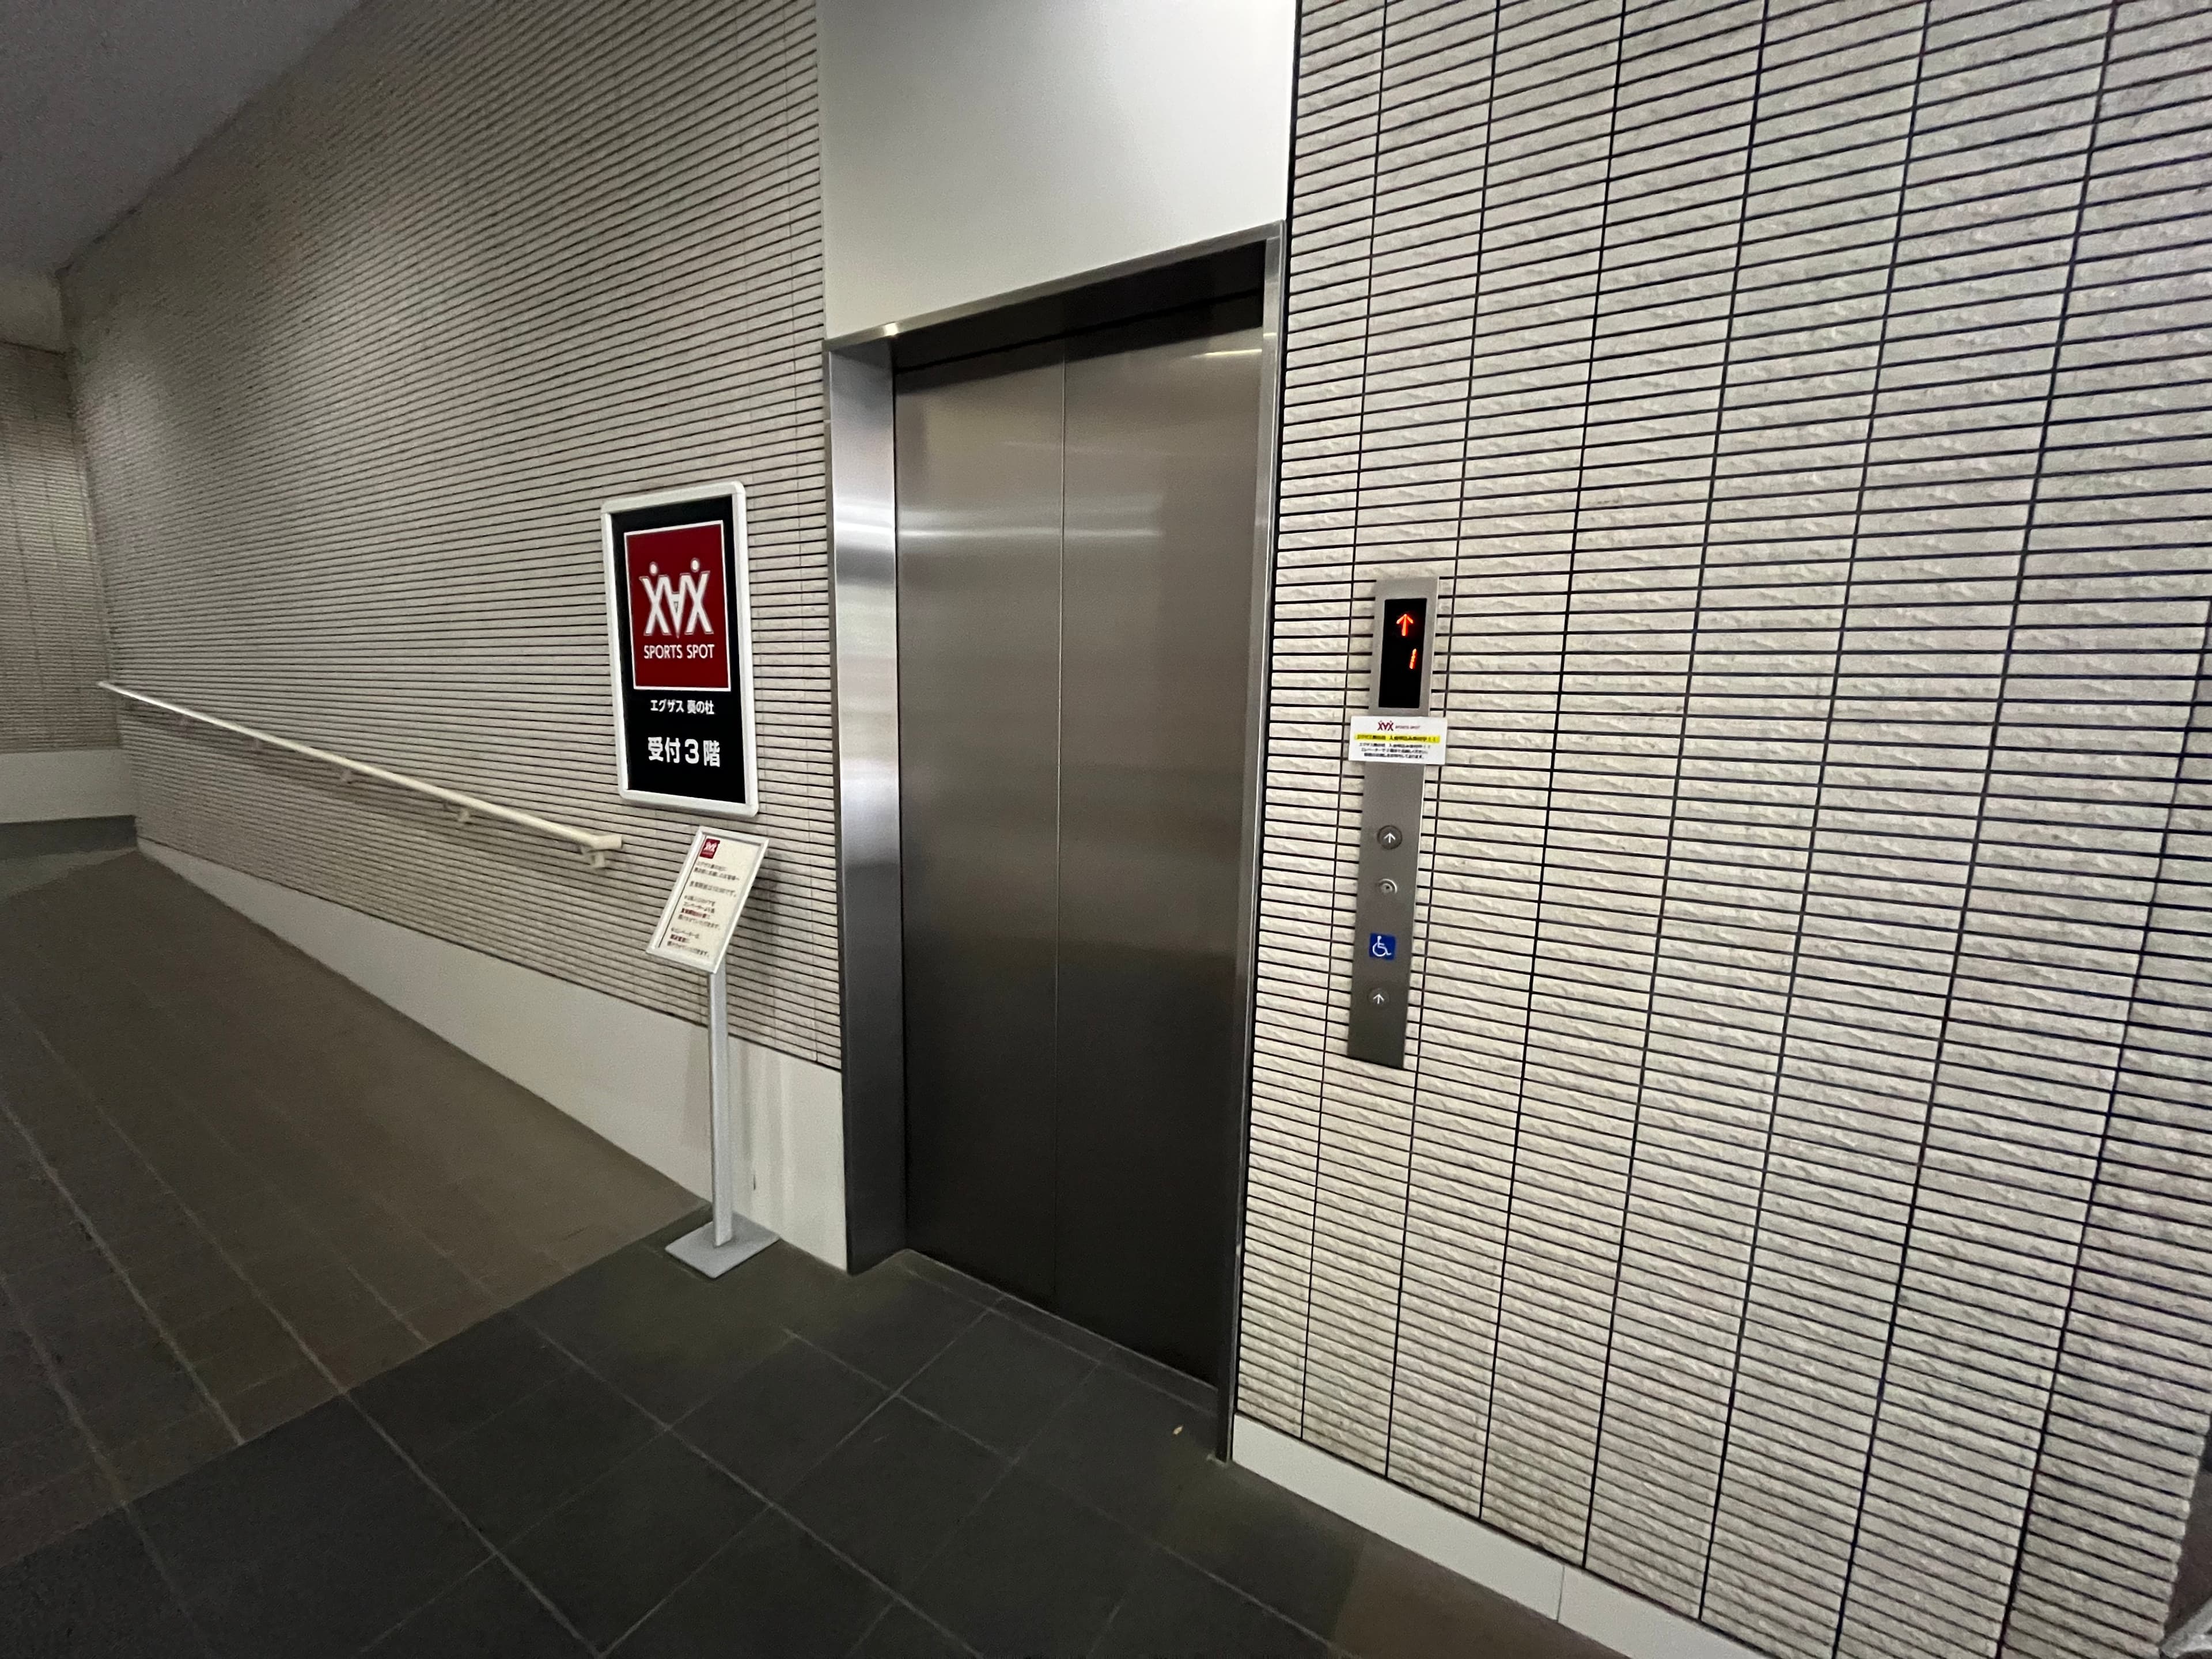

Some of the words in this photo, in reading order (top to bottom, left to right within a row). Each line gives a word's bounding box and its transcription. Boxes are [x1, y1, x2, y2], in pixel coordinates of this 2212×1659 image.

[643, 645, 683, 659] SPORTS
[687, 644, 714, 659] SPOT
[1409, 648, 1418, 669] 1
[650, 698, 684, 713] エグザス
[648, 736, 720, 767] 受付3階
